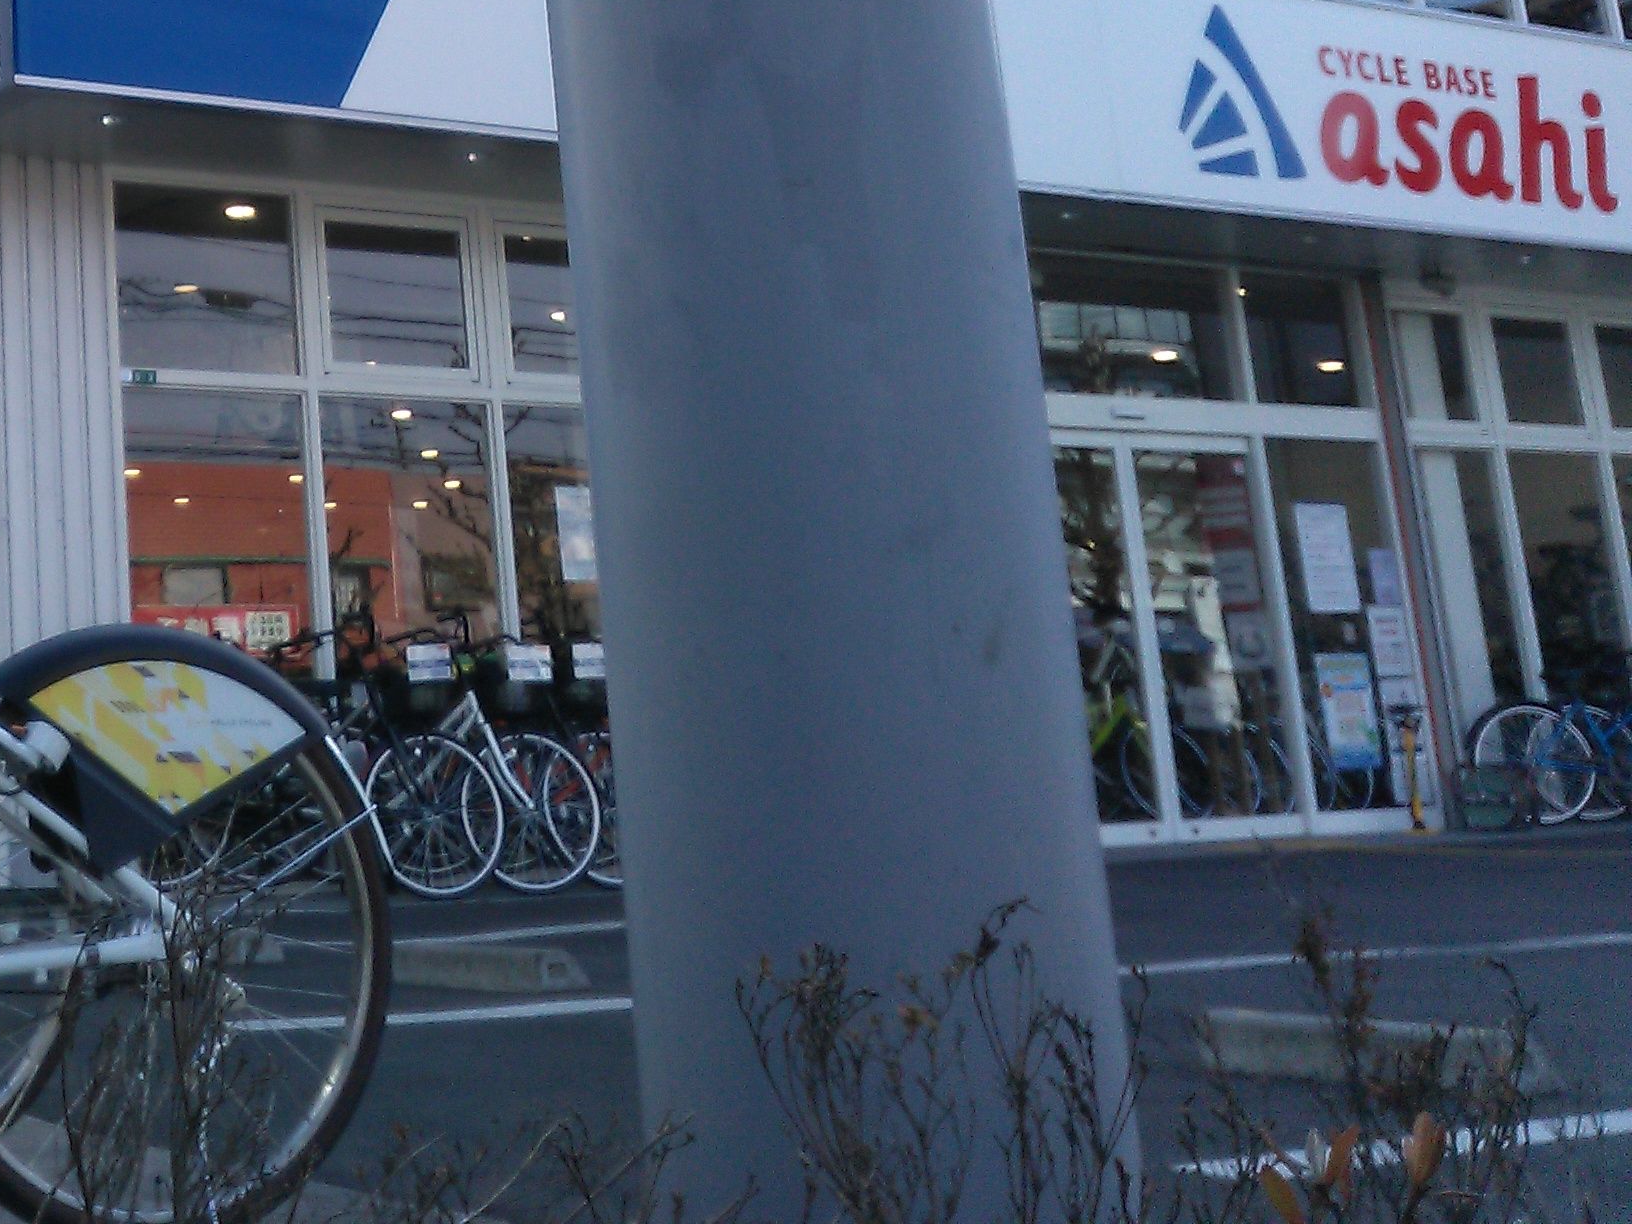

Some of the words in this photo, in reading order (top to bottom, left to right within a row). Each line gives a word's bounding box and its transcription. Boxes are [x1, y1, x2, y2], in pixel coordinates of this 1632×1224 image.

[1318, 45, 1410, 86] CYCLE
[1423, 59, 1497, 98] BASE
[1321, 74, 1619, 212] asahi
